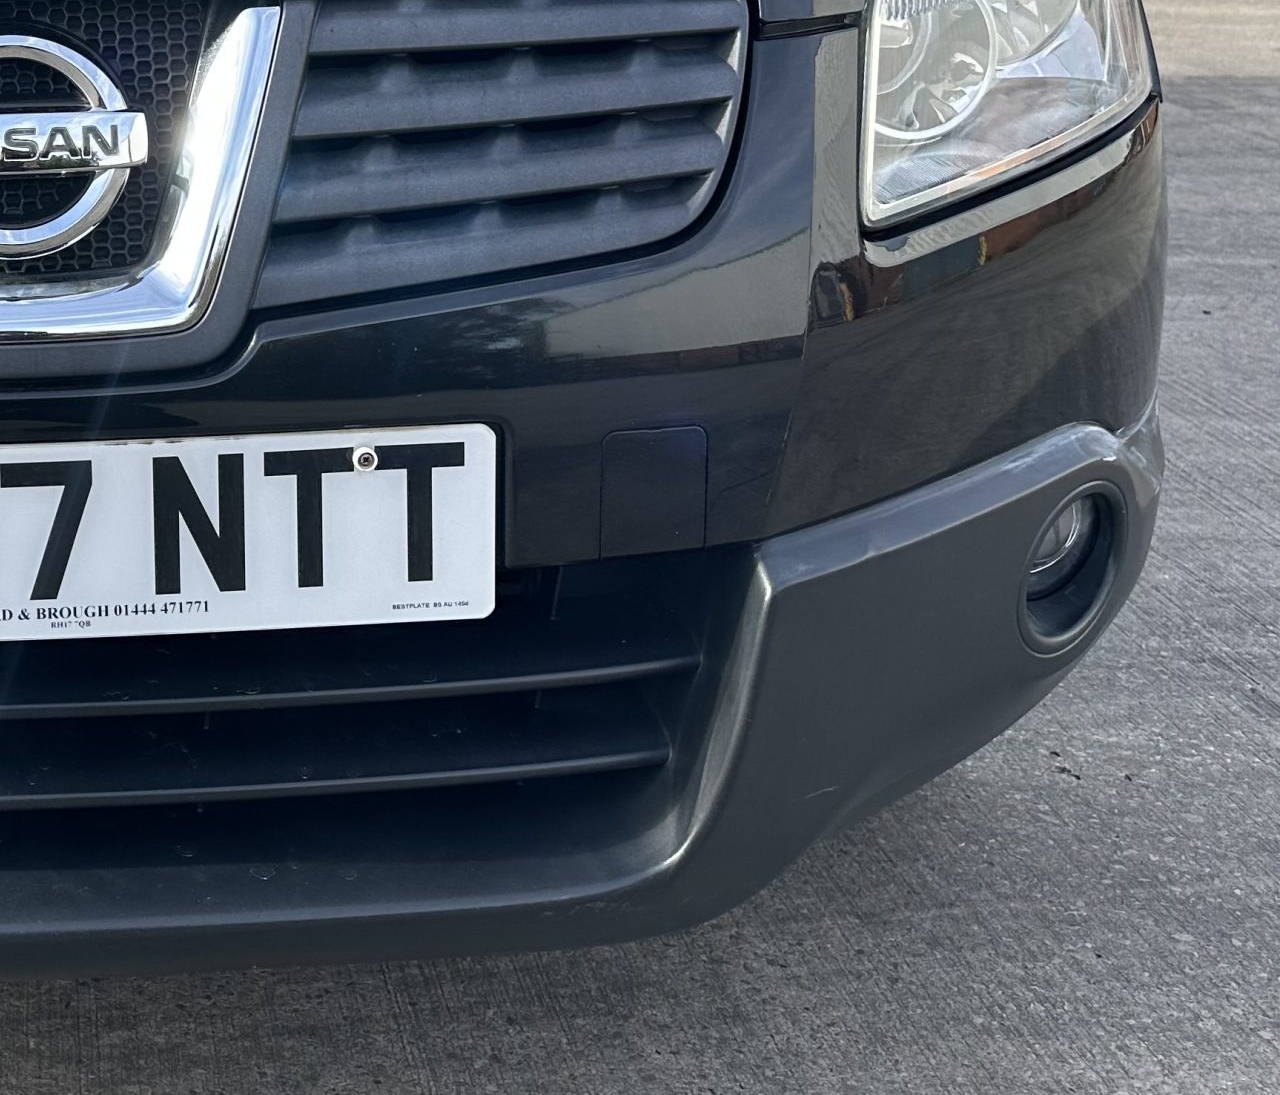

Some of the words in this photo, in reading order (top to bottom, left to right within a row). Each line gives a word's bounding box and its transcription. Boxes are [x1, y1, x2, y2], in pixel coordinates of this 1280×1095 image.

[151, 441, 465, 595] NTT
[17, 608, 31, 621] &
[36, 605, 110, 620] BROUGH
[114, 603, 156, 617] 01444
[160, 600, 209, 614] 471771
[392, 602, 430, 610] BESTPLATE
